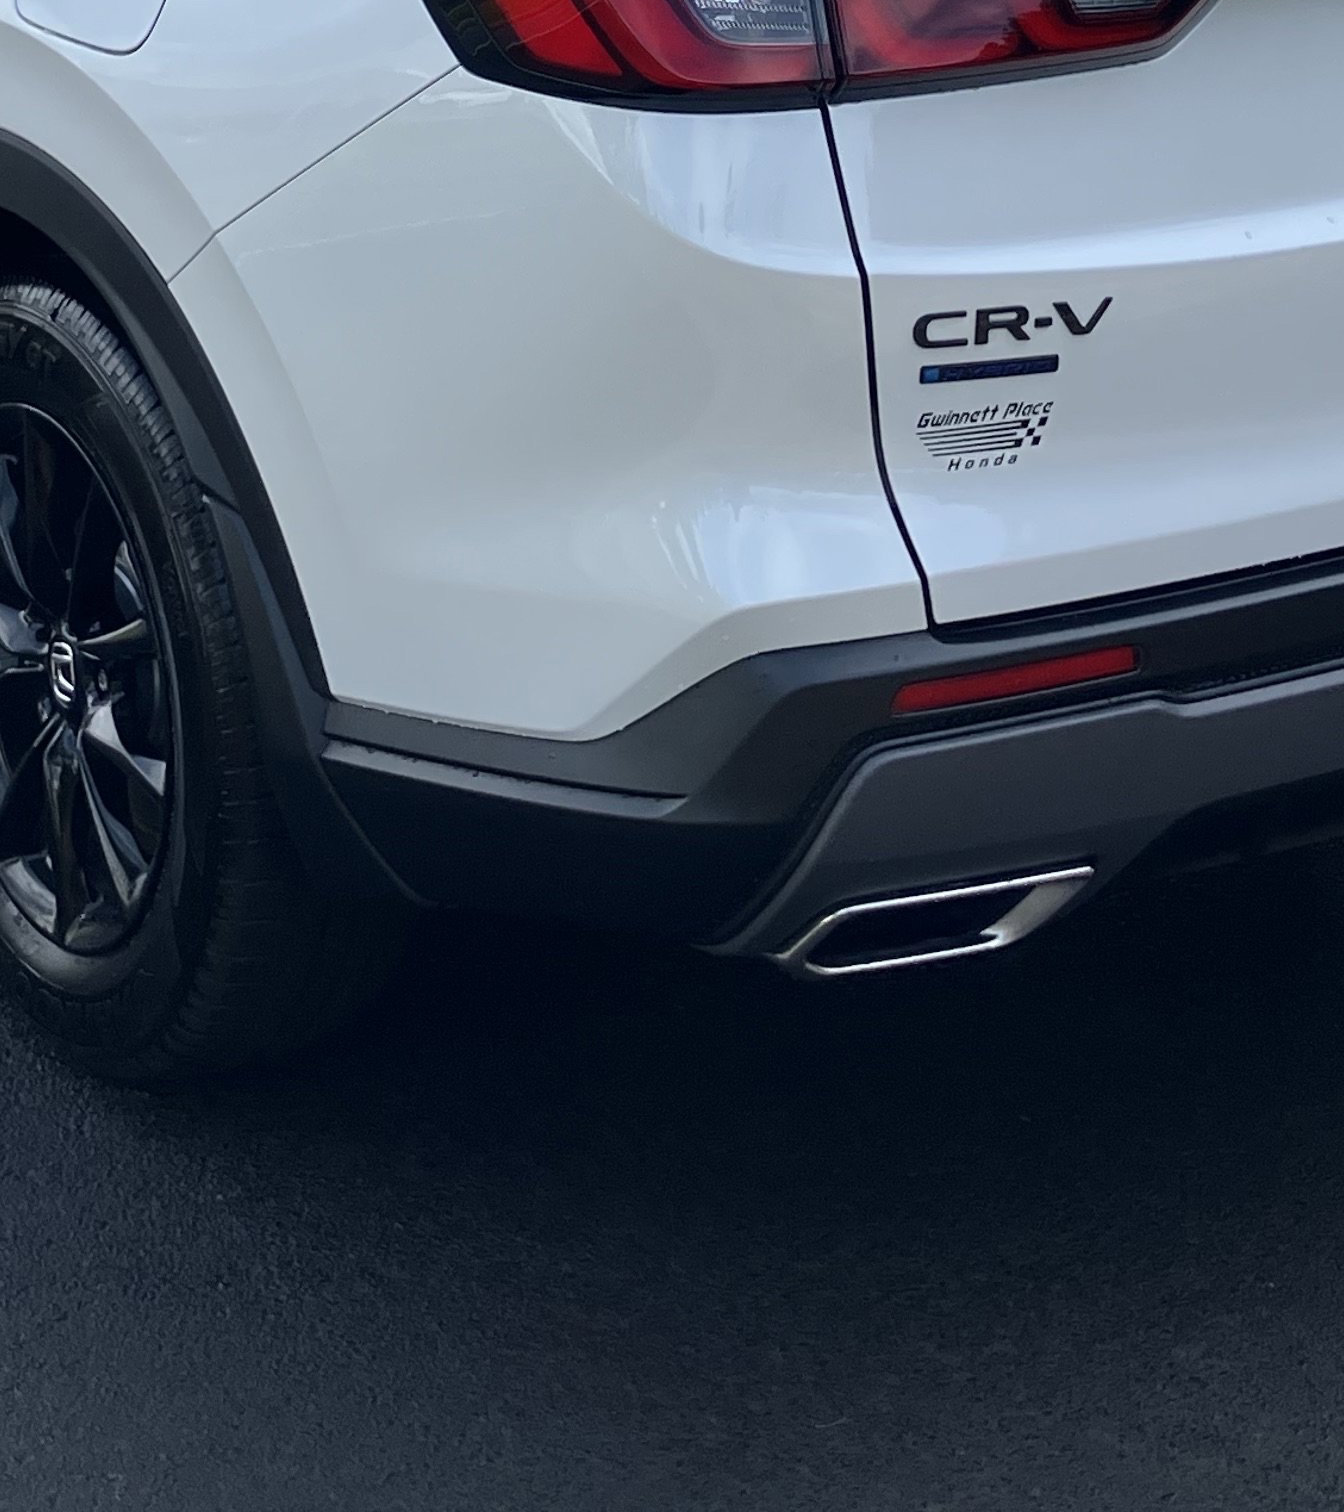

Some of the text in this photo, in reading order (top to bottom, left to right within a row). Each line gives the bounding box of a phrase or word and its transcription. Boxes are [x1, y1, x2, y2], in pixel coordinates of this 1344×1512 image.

[913, 296, 1113, 349] CR-V
[917, 400, 1054, 429] Gwinnett Place
[947, 453, 1018, 472] Honda
